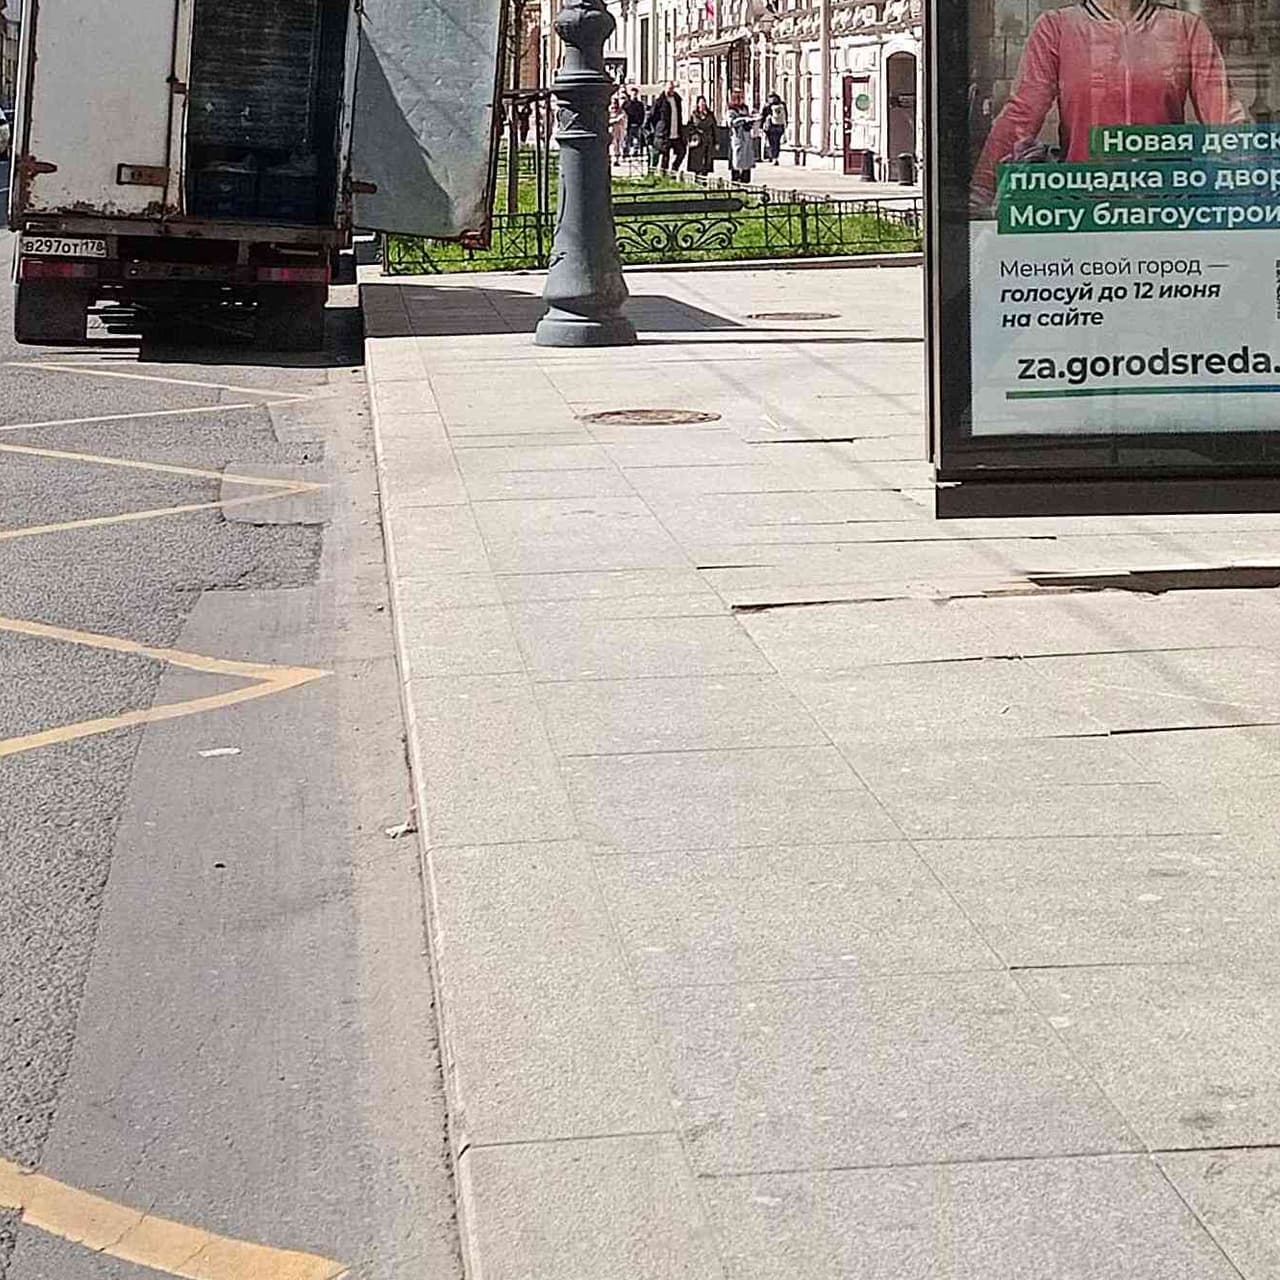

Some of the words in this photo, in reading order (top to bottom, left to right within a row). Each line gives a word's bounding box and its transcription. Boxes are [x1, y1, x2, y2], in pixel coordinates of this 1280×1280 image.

[1103, 130, 1194, 153] Новая
[1010, 170, 1163, 192] площадка
[1172, 170, 1207, 188] во
[1009, 205, 1085, 231] Могу
[1000, 258, 1075, 278] Меняй
[1079, 257, 1131, 276] свой
[1137, 259, 1202, 278] город
[1000, 282, 1093, 305] голосуй
[1097, 285, 1128, 303] до
[1133, 281, 1154, 299] 12
[1158, 283, 1221, 298] июня
[1002, 312, 1031, 328] на
[1037, 307, 1104, 326] сайте
